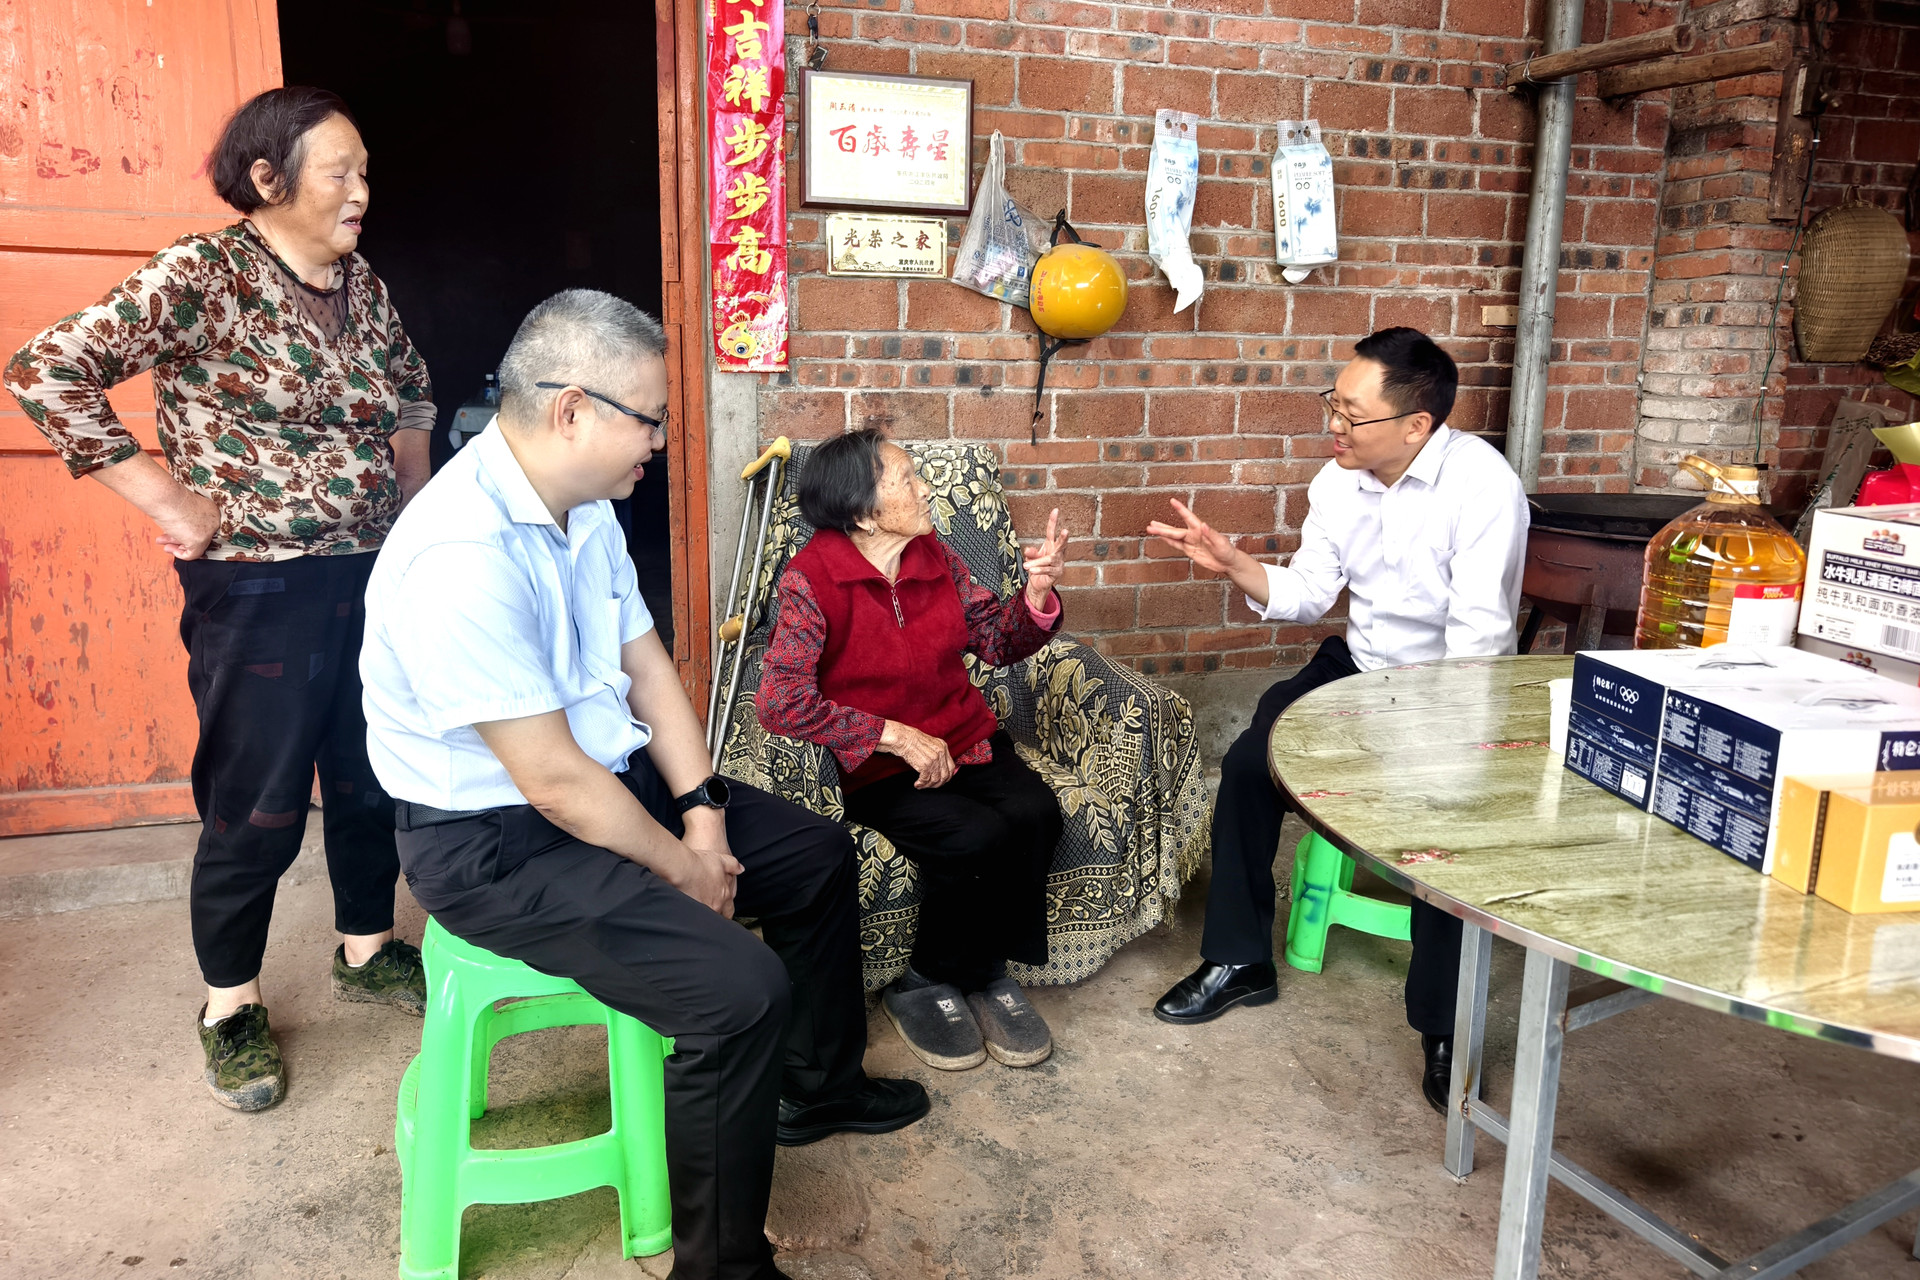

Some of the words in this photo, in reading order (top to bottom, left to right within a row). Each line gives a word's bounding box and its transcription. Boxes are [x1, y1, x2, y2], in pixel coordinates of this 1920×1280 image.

[723, 0, 773, 275] 吉祥步步高
[1278, 193, 1287, 227] 1600
[843, 228, 932, 251] 光荣之家
[714, 295, 740, 310] 吉祥
